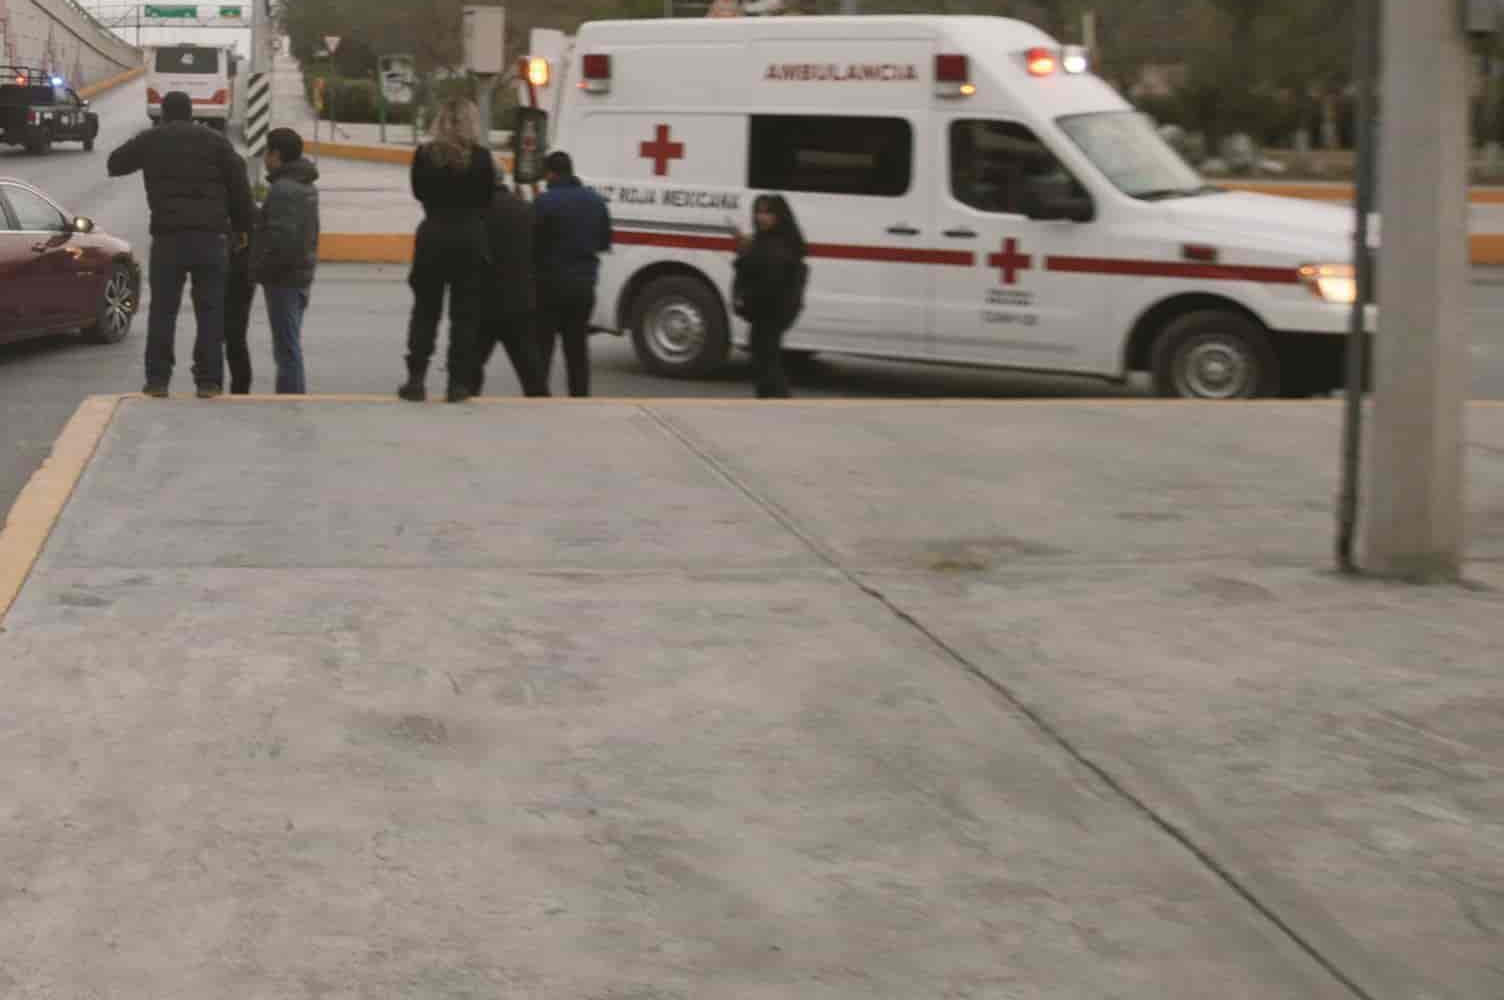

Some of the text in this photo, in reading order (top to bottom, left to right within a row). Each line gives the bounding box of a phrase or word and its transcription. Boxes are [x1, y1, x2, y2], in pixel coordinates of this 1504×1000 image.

[763, 63, 919, 81] AMBULANCIA
[619, 186, 656, 204] ROJA
[662, 190, 740, 209] MEXICANA
